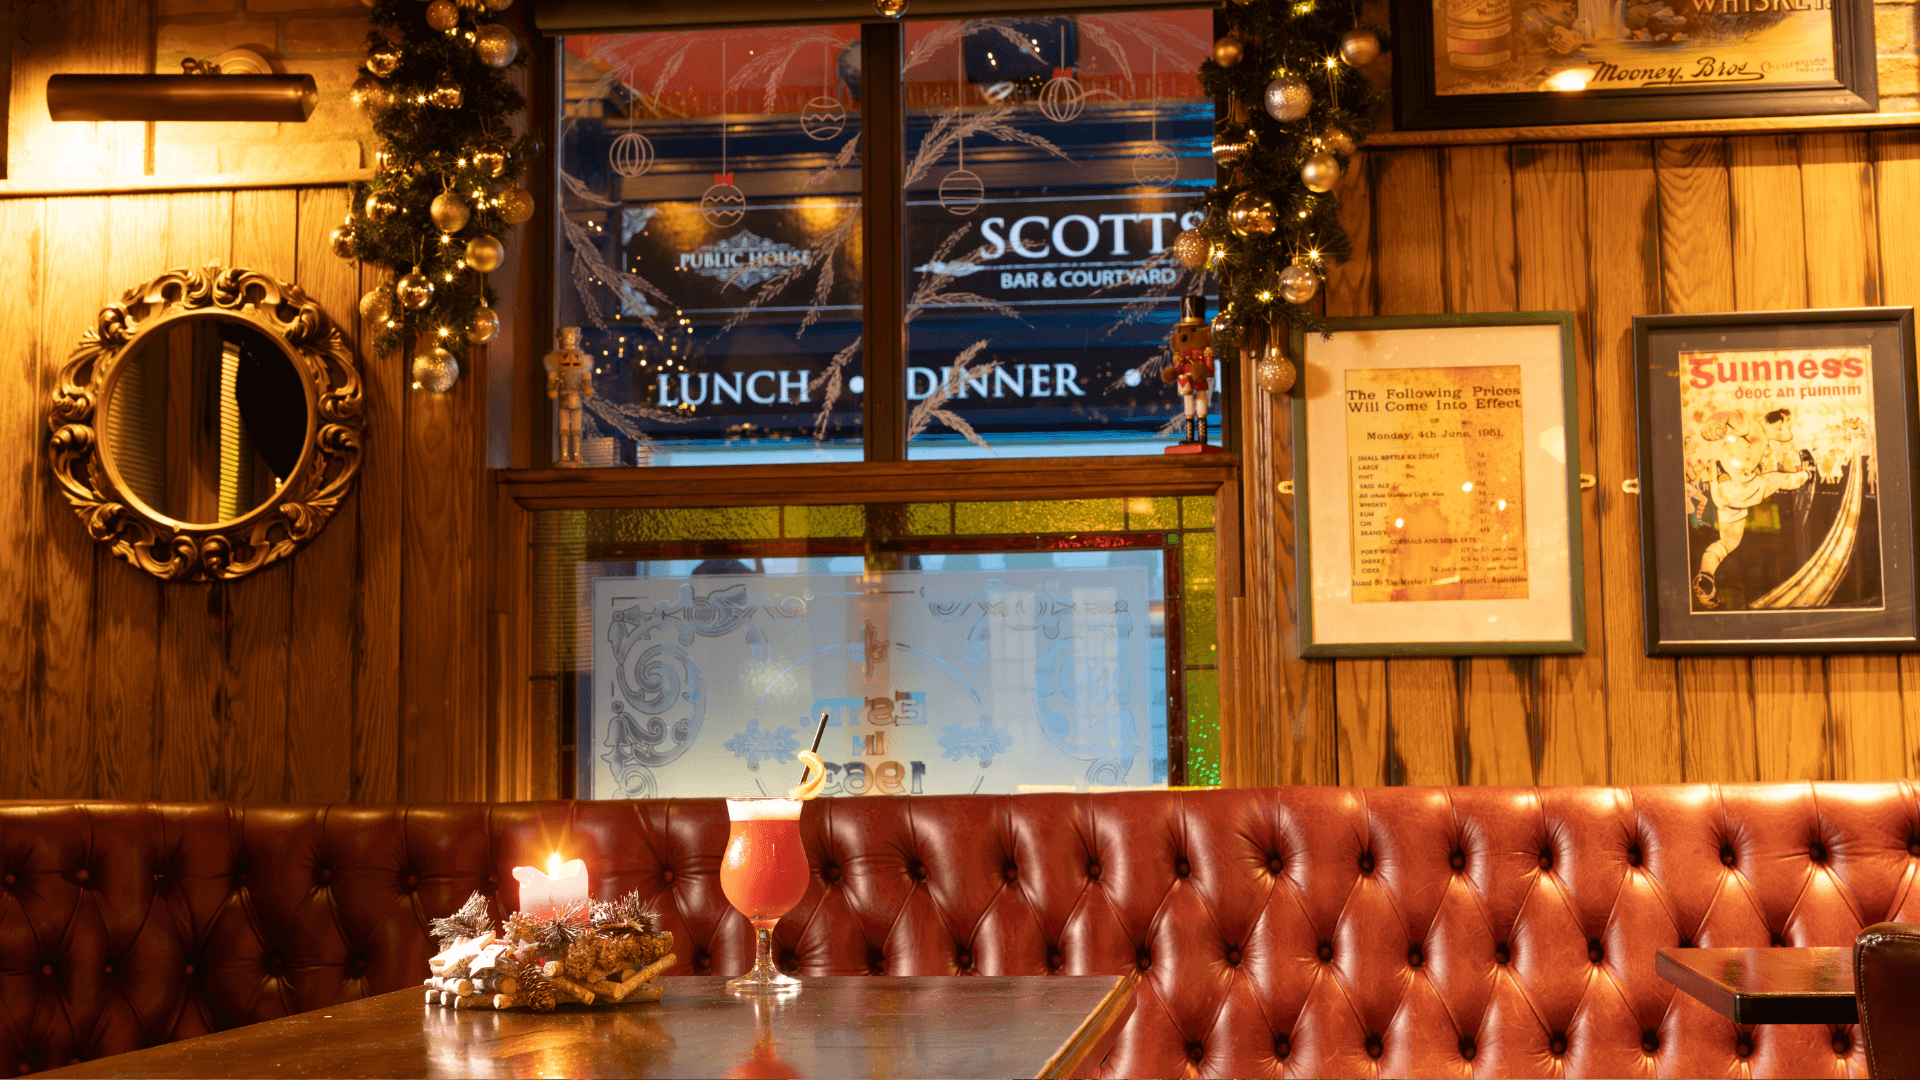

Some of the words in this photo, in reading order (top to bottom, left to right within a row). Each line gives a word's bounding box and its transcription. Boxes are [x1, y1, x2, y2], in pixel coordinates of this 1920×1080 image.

[680, 252, 743, 268] PUBLIC
[749, 250, 811, 266] HOUSE
[1001, 272, 1039, 289] BAR
[1041, 271, 1057, 287] &
[1060, 268, 1177, 286] COURTYARD
[657, 370, 811, 406] LUNCH
[906, 363, 1086, 400] DINNER
[1347, 390, 1376, 400] The
[1386, 388, 1462, 400] Following
[1473, 386, 1520, 396] Prices
[1348, 402, 1379, 412] Will
[1385, 401, 1428, 412] Come
[1437, 400, 1467, 410] Into
[1476, 398, 1521, 409] Effect
